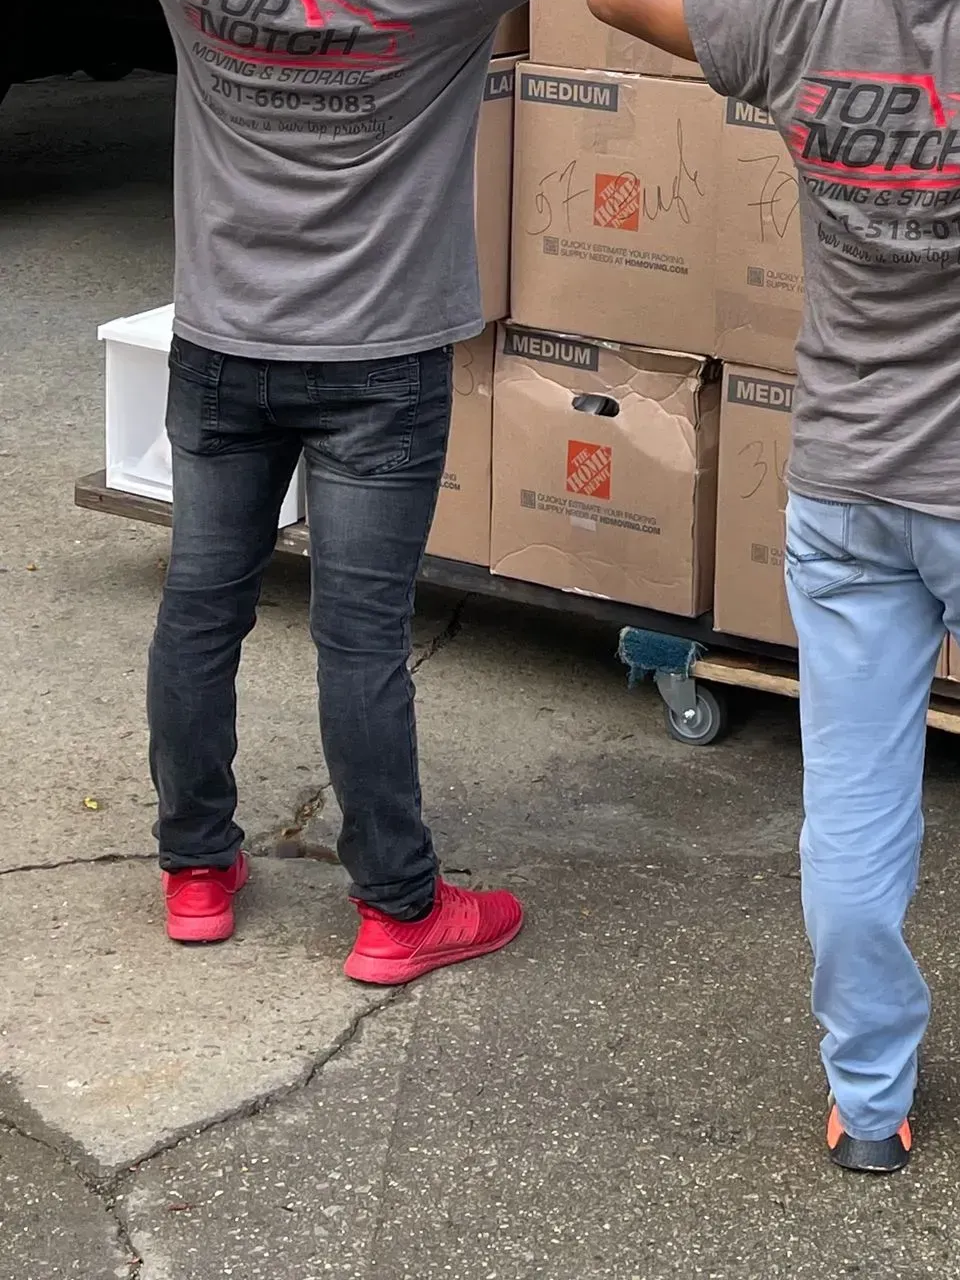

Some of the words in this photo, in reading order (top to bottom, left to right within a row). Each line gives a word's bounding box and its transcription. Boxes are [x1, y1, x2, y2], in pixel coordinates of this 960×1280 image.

[184, 3, 361, 56] NOTCH
[192, 42, 256, 76] MOVING
[259, 64, 273, 80] &
[276, 67, 374, 86] STORAGE
[211, 73, 377, 114] 201-660-3083
[528, 78, 610, 106] MEDIUM
[802, 76, 920, 126] TOP
[307, 119, 328, 140] top
[802, 176, 870, 203] OVING
[874, 188, 891, 206] &
[560, 239, 591, 252] QUICKLY
[593, 243, 627, 257] ESTIMATE
[629, 248, 650, 261] YOUR
[651, 252, 684, 265] PACKING
[560, 249, 588, 261] SUPPLY
[590, 253, 614, 265] NEEDS
[615, 256, 624, 265] AT
[624, 258, 688, 275] HDMOVING.COM
[892, 251, 920, 264] our
[926, 248, 950, 267] top
[513, 335, 590, 365] MEDIUM
[566, 446, 612, 493] HOME
[572, 449, 590, 467] THE
[583, 468, 610, 496] DEPOT
